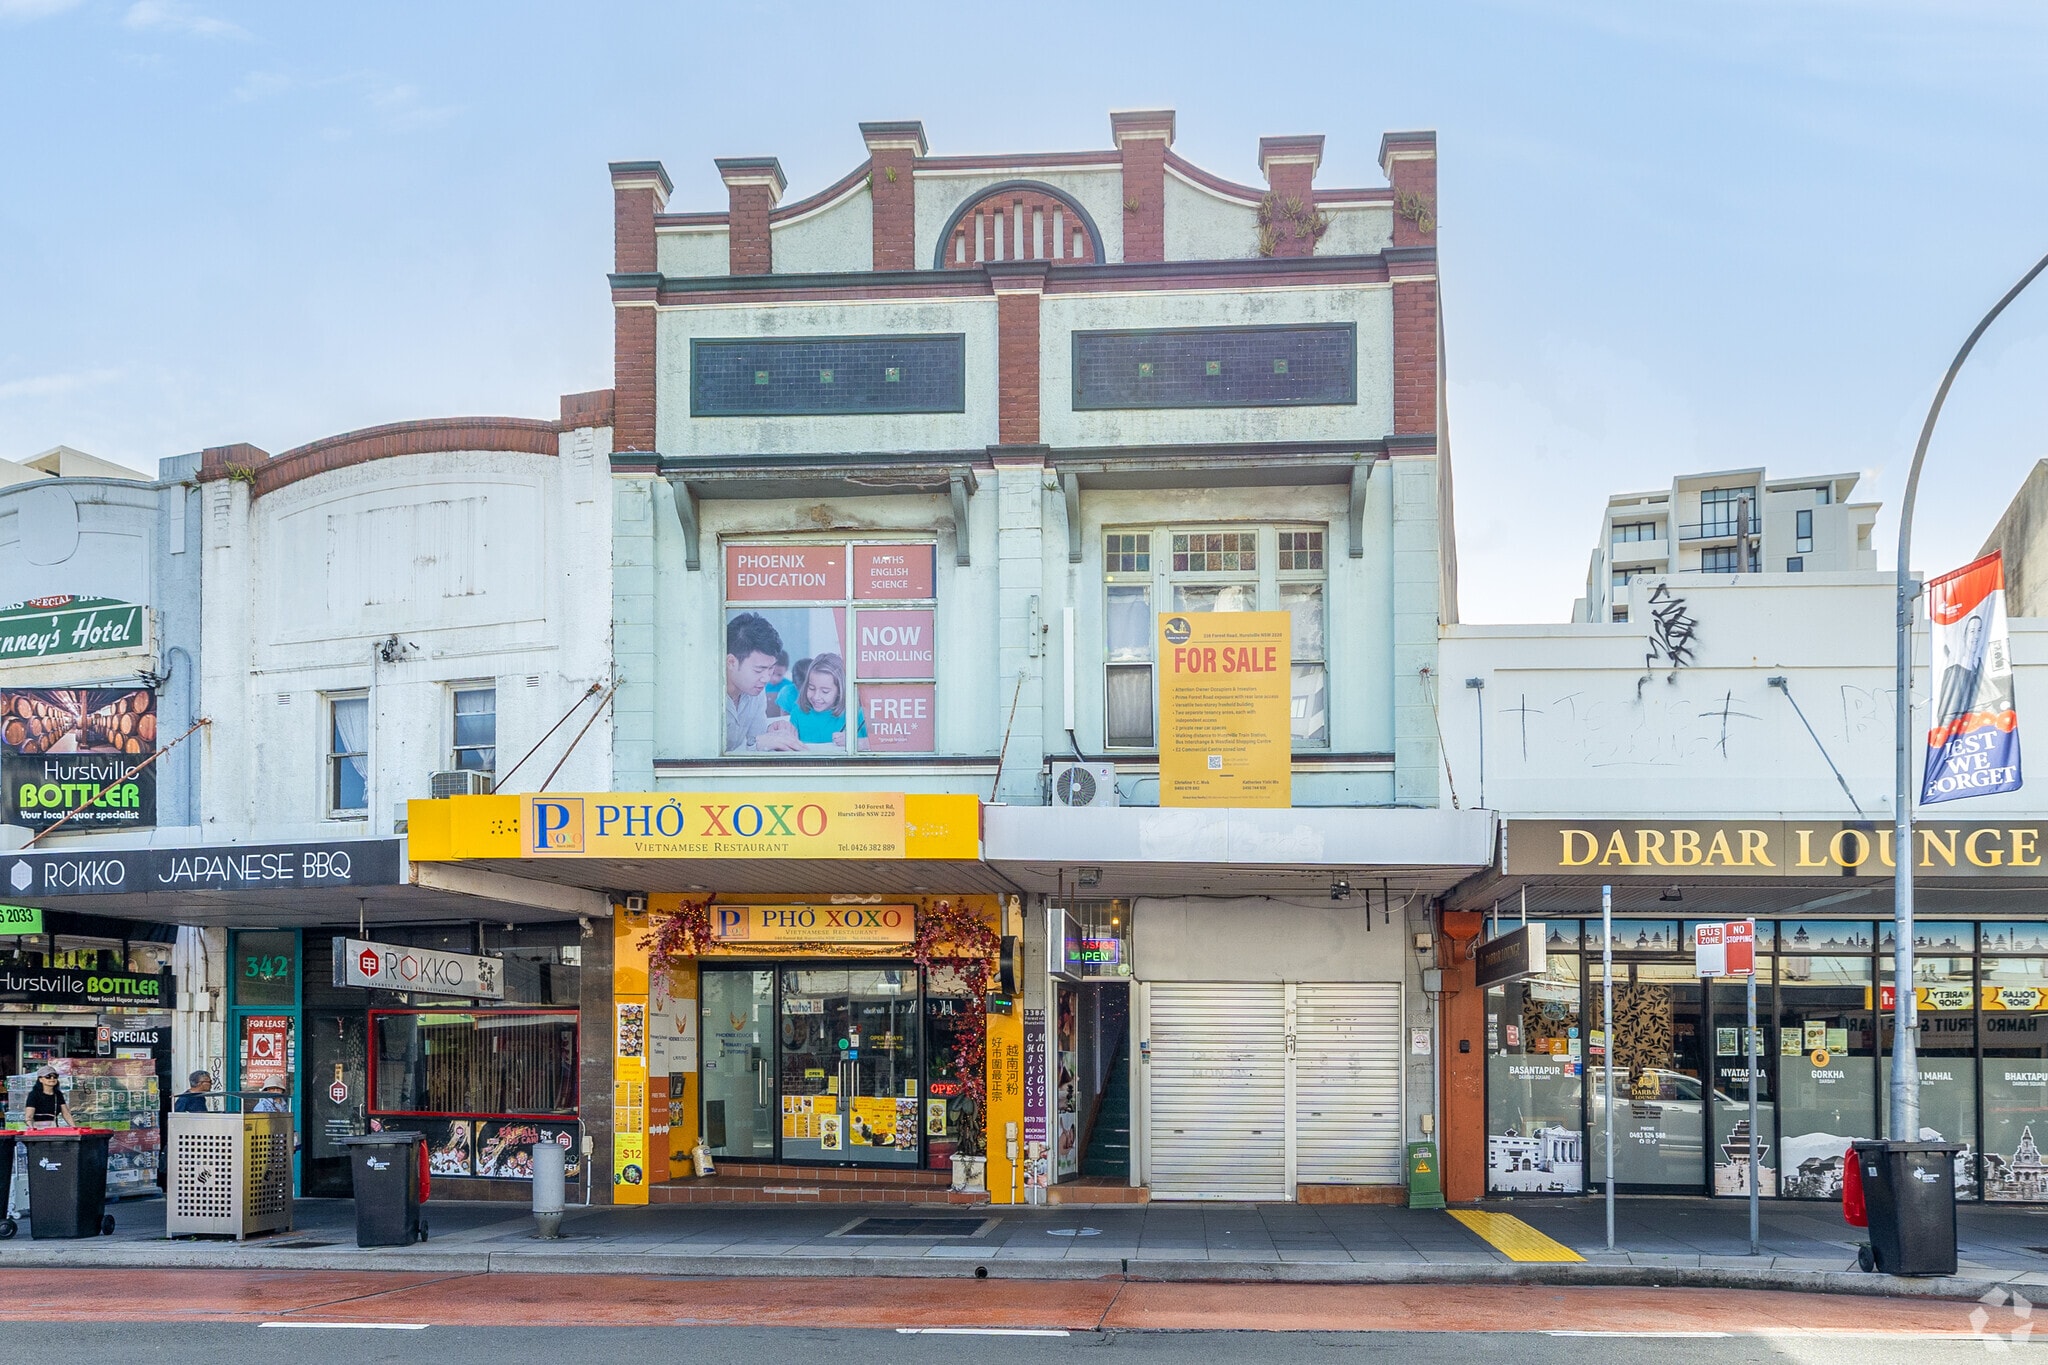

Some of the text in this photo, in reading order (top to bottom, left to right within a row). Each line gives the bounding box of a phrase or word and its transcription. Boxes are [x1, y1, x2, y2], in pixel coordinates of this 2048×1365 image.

[738, 555, 805, 569] PHOENIX
[872, 556, 904, 565] MATHS
[737, 573, 826, 587] EDUCATION
[870, 568, 909, 576] ENGLISH
[871, 580, 908, 588] SCIENCE
[0, 608, 136, 656] nney's Hotel
[862, 626, 921, 646] NOW
[861, 650, 932, 662] ENROLLING
[1174, 646, 1277, 673] FOR SALE
[870, 698, 927, 719] FREE
[44, 761, 140, 780] Hurstville
[1946, 752, 1991, 775] WE
[20, 783, 140, 808] BOTTLER
[20, 810, 42, 819] Your
[44, 810, 65, 819] local
[96, 810, 139, 820] specialist
[700, 804, 828, 837] XOXO
[635, 842, 789, 852] VIETNAMESE RESTAURANT
[1559, 828, 2042, 867] DARBAR LOUNGE
[44, 851, 352, 888] ROKKO JAPANESE BBQ
[8, 909, 34, 923] 2033
[825, 910, 902, 928] XOXO
[1733, 925, 1745, 935] NO
[1726, 935, 1753, 943] STOPPING
[245, 955, 288, 978] 342
[385, 951, 464, 986] ROKKO
[87, 977, 160, 996] BOTTLER
[250, 1020, 285, 1028] FOR LEASE
[112, 1031, 158, 1043] SPECIALS
[1006, 1044, 1019, 1096] 越南河粉
[1025, 1033, 1035, 1108] CHINESE
[1035, 1033, 1046, 1107] MASSAGE
[1509, 1066, 1560, 1075] BASANTAPUR
[1811, 1070, 1844, 1079] GORKHA
[1924, 1072, 1953, 1081] MAHAL
[622, 1149, 642, 1159] $12
